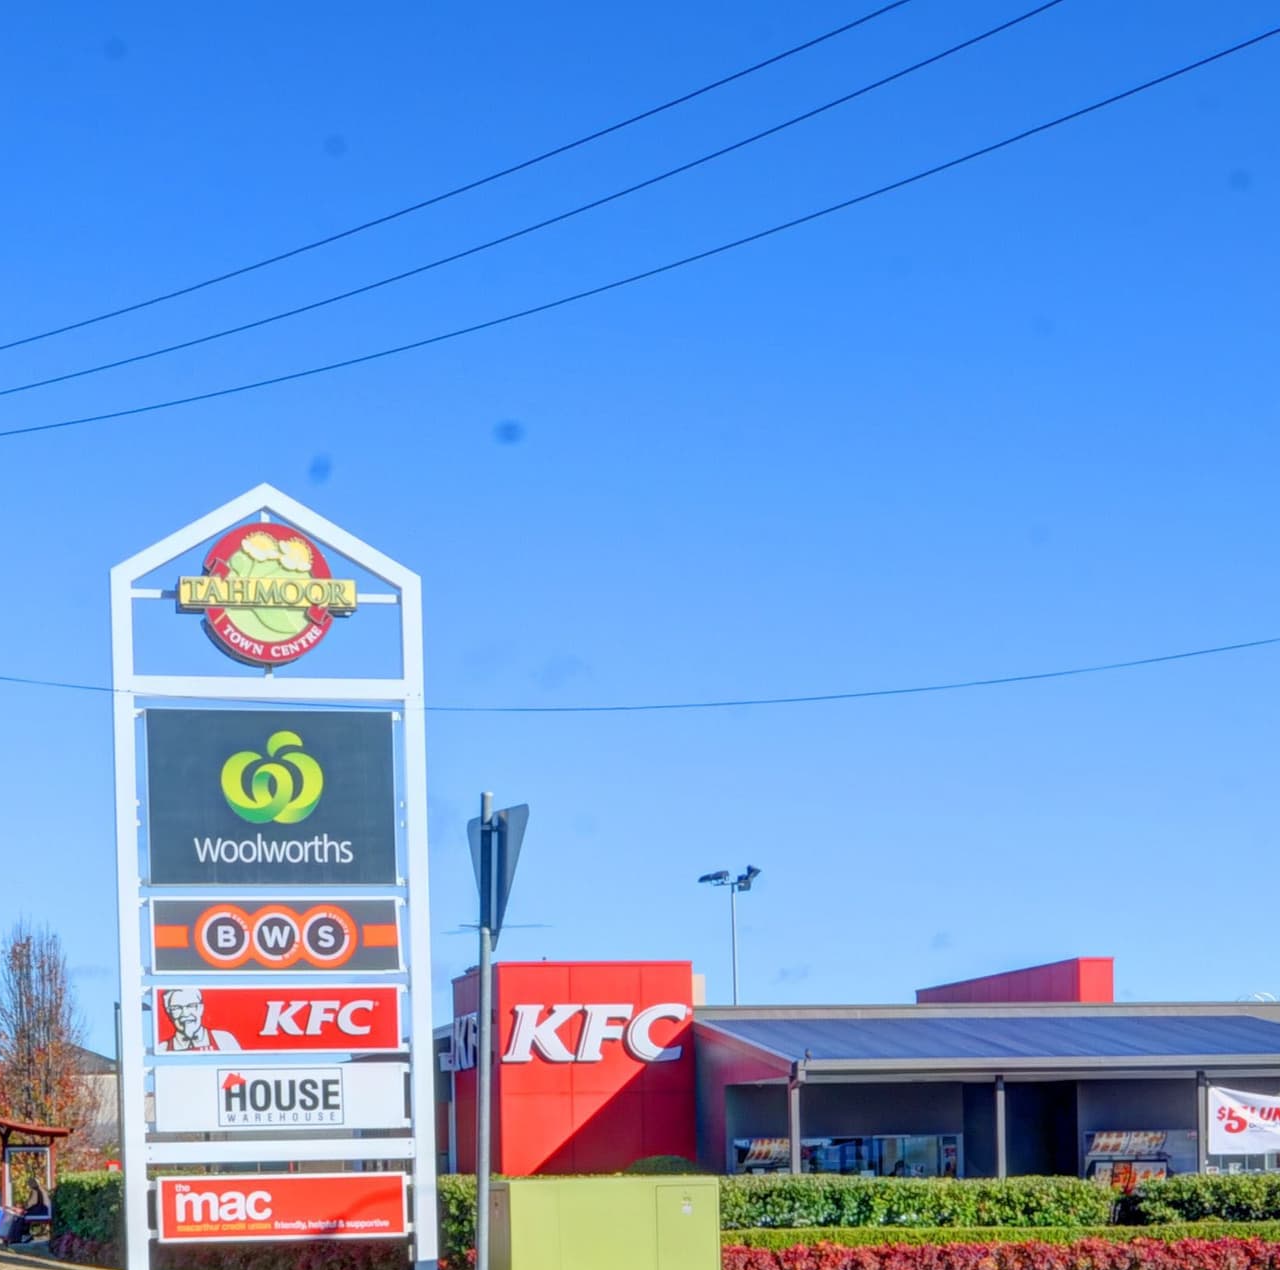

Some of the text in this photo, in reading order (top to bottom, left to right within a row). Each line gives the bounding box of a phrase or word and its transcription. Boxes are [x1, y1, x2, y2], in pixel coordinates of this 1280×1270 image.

[182, 578, 352, 607] TAHMOOR
[223, 623, 323, 658] TOWN CENTRE
[194, 833, 353, 863] Woolworths
[259, 1000, 375, 1036] KFC
[501, 1003, 688, 1063] KFC
[223, 1076, 340, 1112] HOUSE
[227, 1112, 336, 1122] WAREHOUSE
[175, 1184, 190, 1192] the
[176, 1190, 272, 1222] mac
